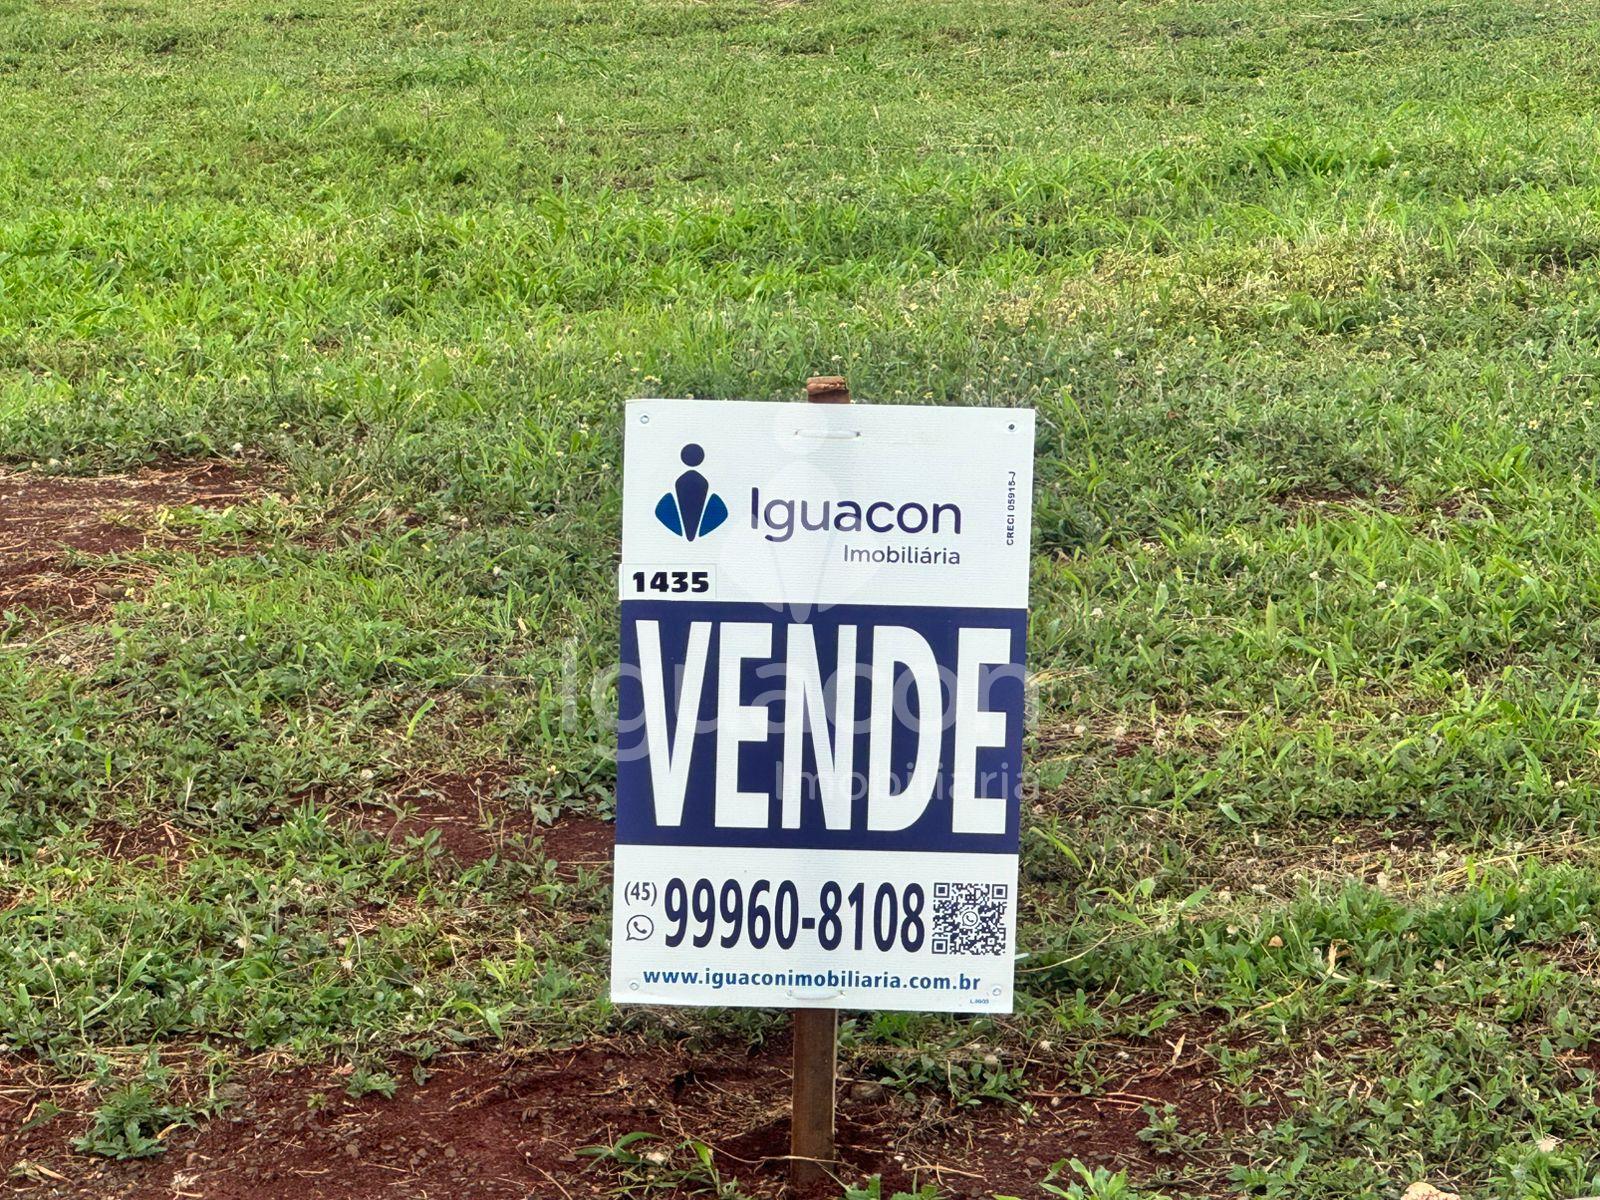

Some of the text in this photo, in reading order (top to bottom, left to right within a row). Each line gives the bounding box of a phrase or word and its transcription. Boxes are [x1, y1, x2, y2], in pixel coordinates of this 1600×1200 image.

[751, 487, 961, 542] Iguacon
[1006, 471, 1016, 546] CRECI 05915-J
[632, 571, 710, 593] 1435
[843, 545, 961, 565] Imobiliária
[635, 619, 1012, 834] VENDE
[624, 877, 926, 953] (45) 99960-8108
[643, 968, 981, 990] www.iguaconimobiliaria.com.br
